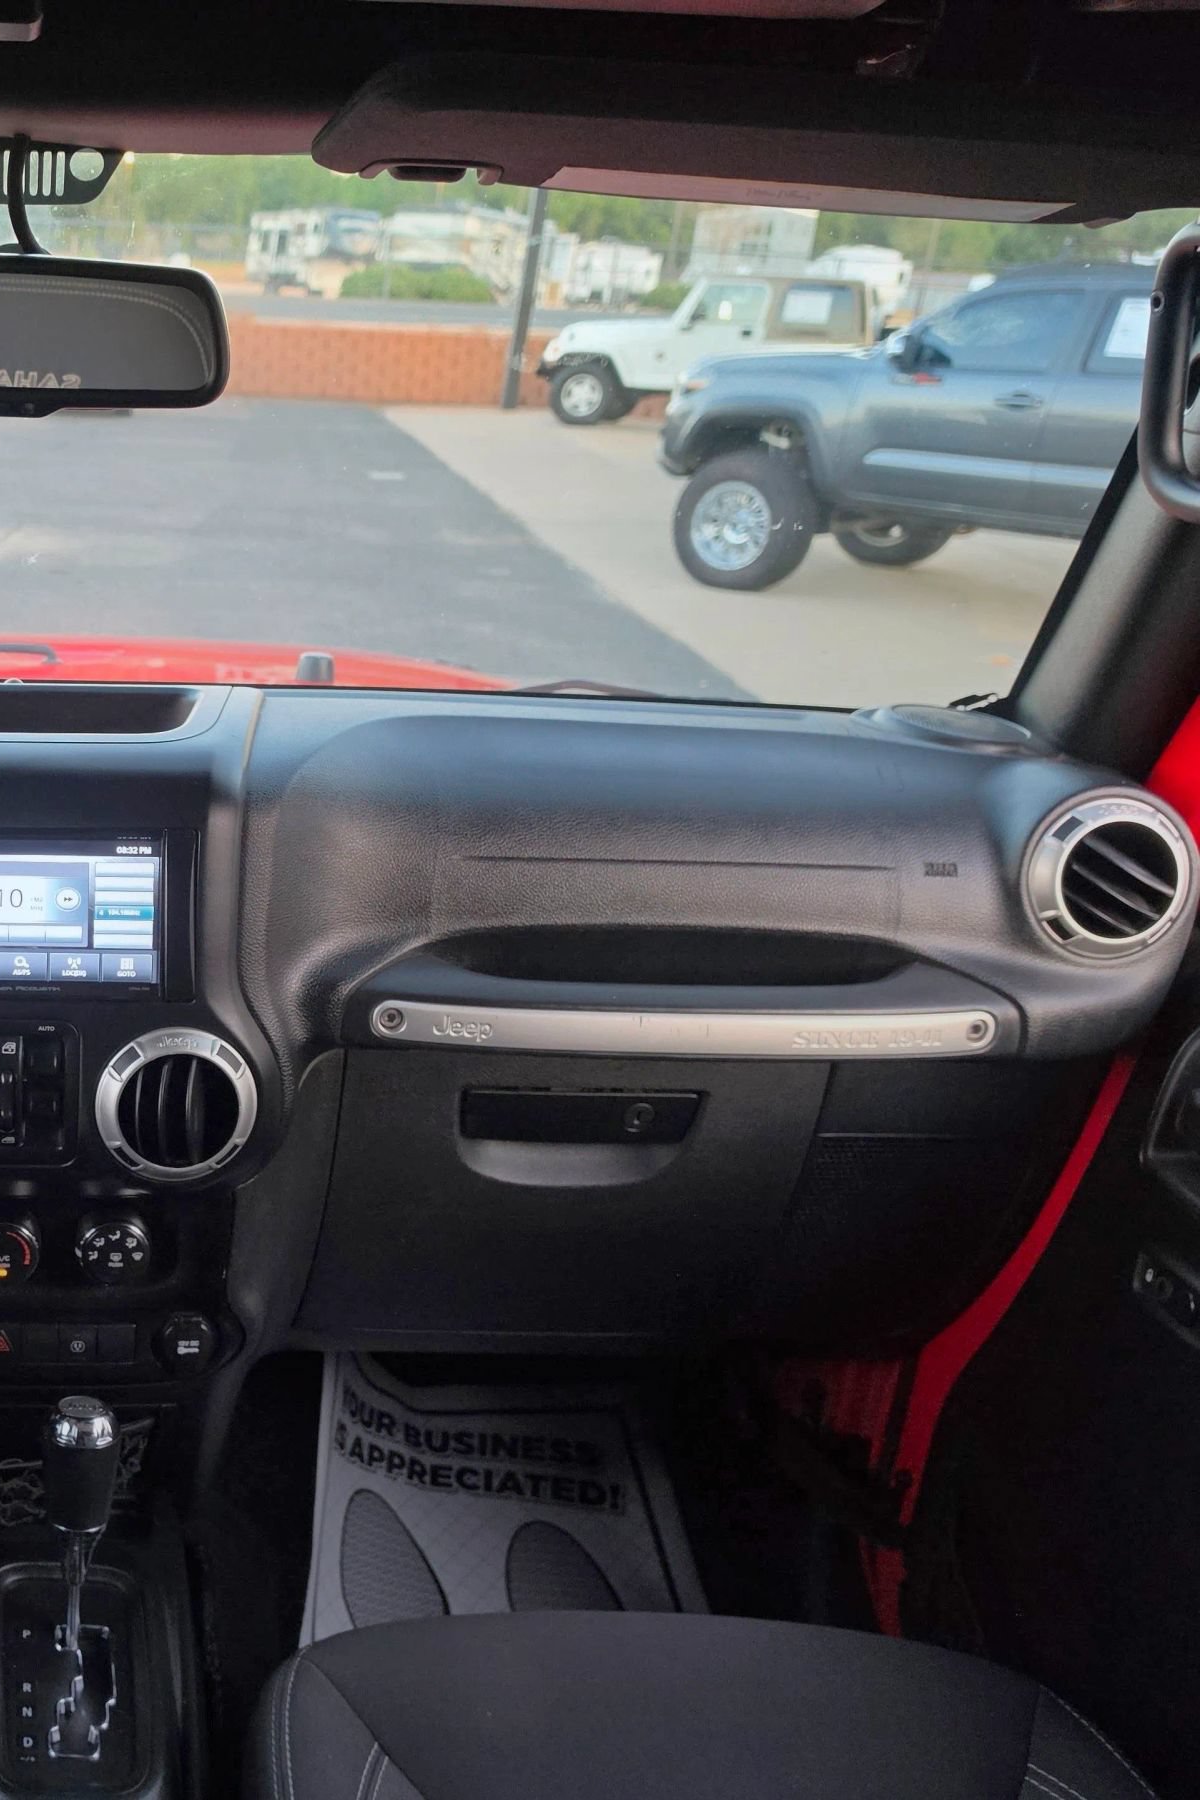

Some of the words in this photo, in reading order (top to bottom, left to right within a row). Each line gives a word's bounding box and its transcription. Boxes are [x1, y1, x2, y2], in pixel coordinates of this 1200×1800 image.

[139, 846, 152, 855] PM
[432, 1015, 493, 1042] Jeep
[792, 1030, 879, 1049] SINCE
[403, 1424, 600, 1466] BUSINESS
[349, 1436, 622, 1509] APPRECIATED!
[22, 1629, 31, 1639] P
[22, 1682, 32, 1693] R
[22, 1706, 33, 1717] N
[22, 1736, 33, 1748] D
